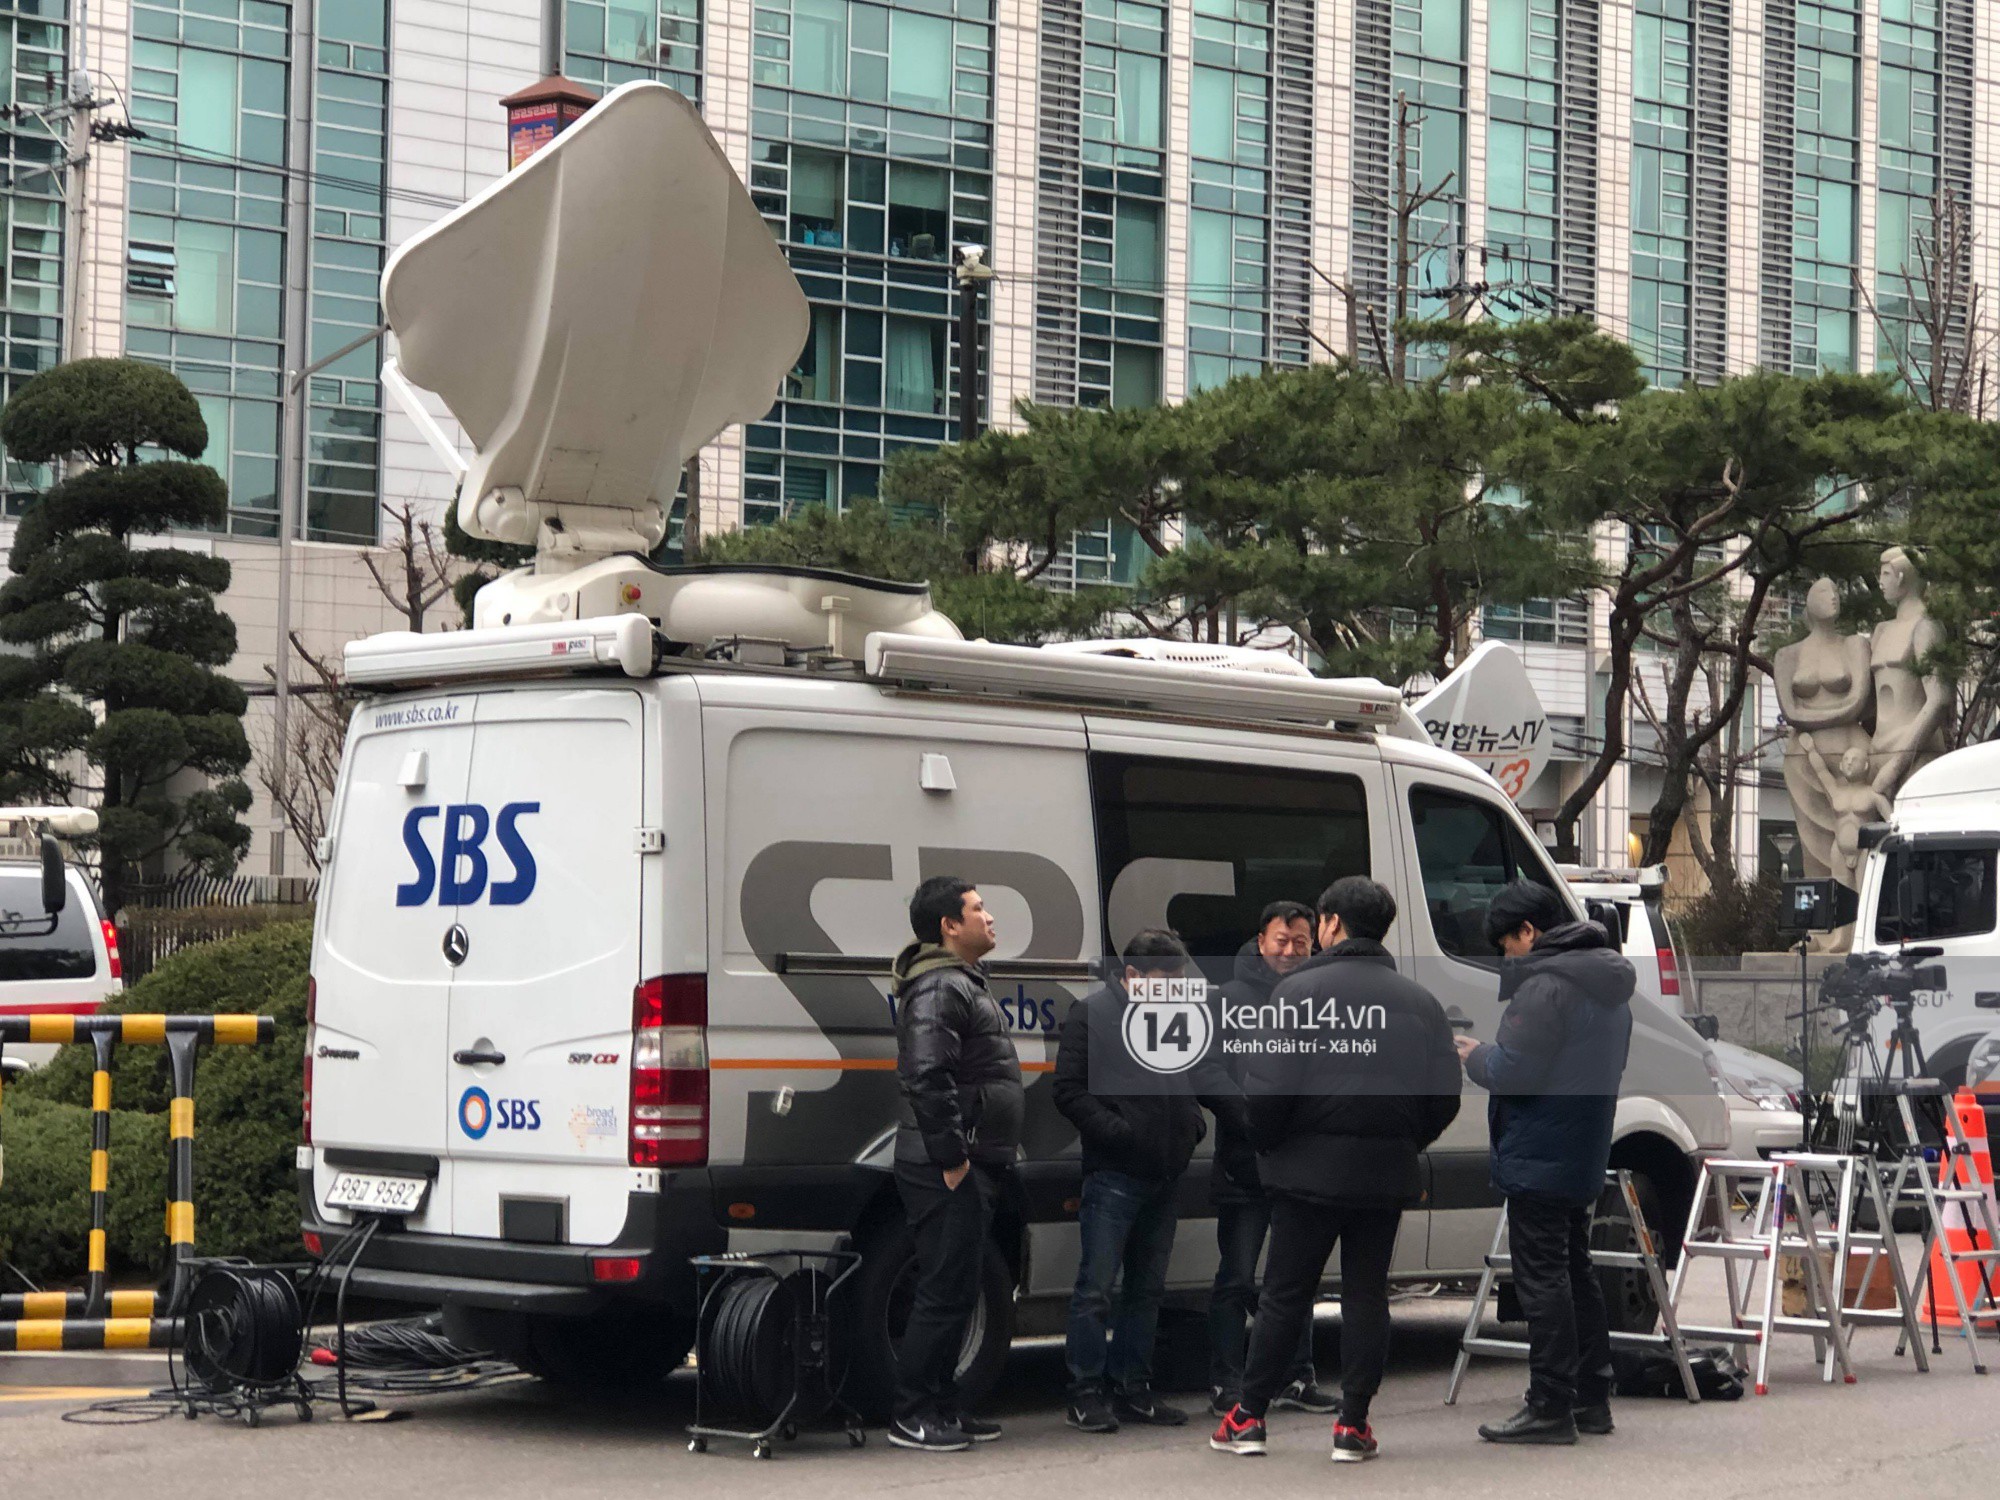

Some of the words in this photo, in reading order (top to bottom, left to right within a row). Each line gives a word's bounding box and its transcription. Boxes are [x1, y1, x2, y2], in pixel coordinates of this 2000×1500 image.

[375, 701, 459, 729] www.sbs.co.kr
[396, 801, 541, 907] SBS
[496, 1098, 541, 1130] SBS
[373, 1180, 417, 1206] 9582
